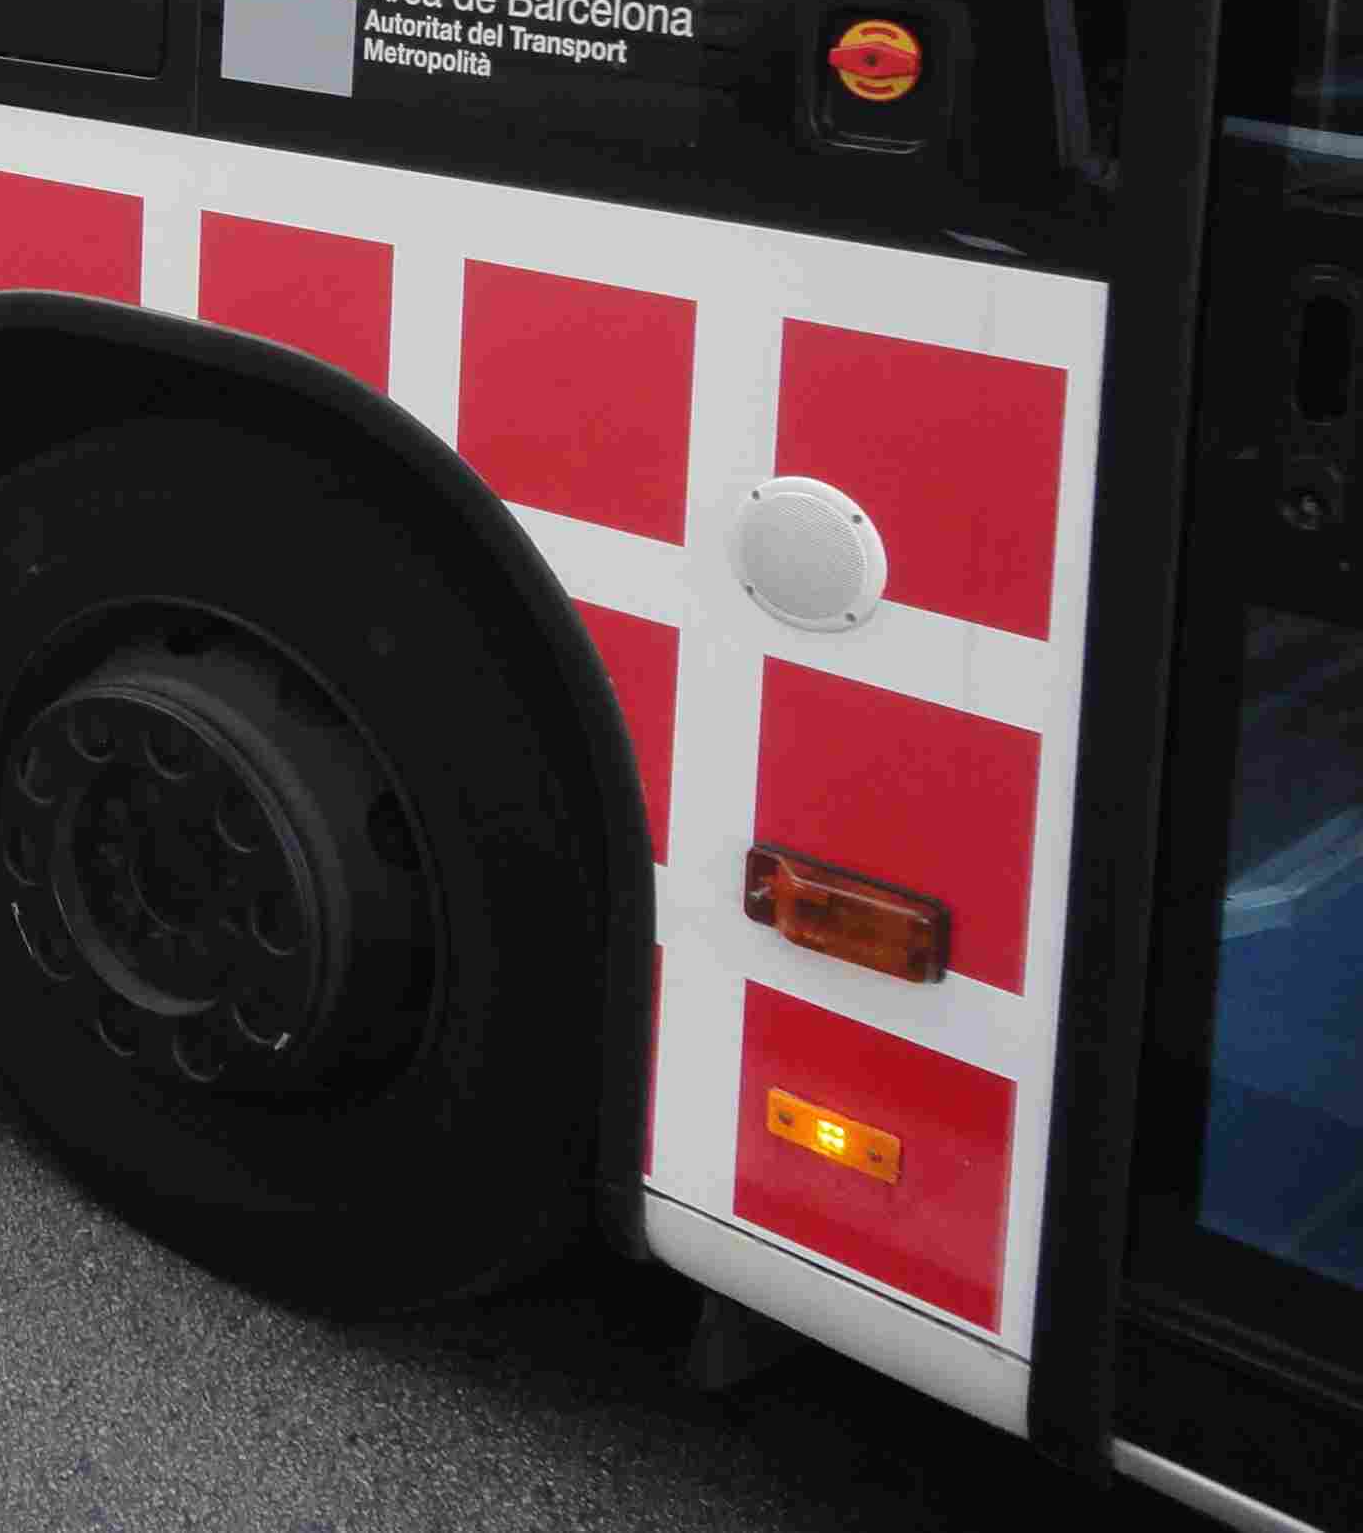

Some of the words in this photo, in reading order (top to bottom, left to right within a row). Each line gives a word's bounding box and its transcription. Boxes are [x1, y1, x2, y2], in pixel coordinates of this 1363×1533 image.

[363, 8, 462, 44] Autoritat
[467, 20, 504, 49] del
[510, 25, 628, 64] Transport
[363, 37, 493, 78] Metropolità
